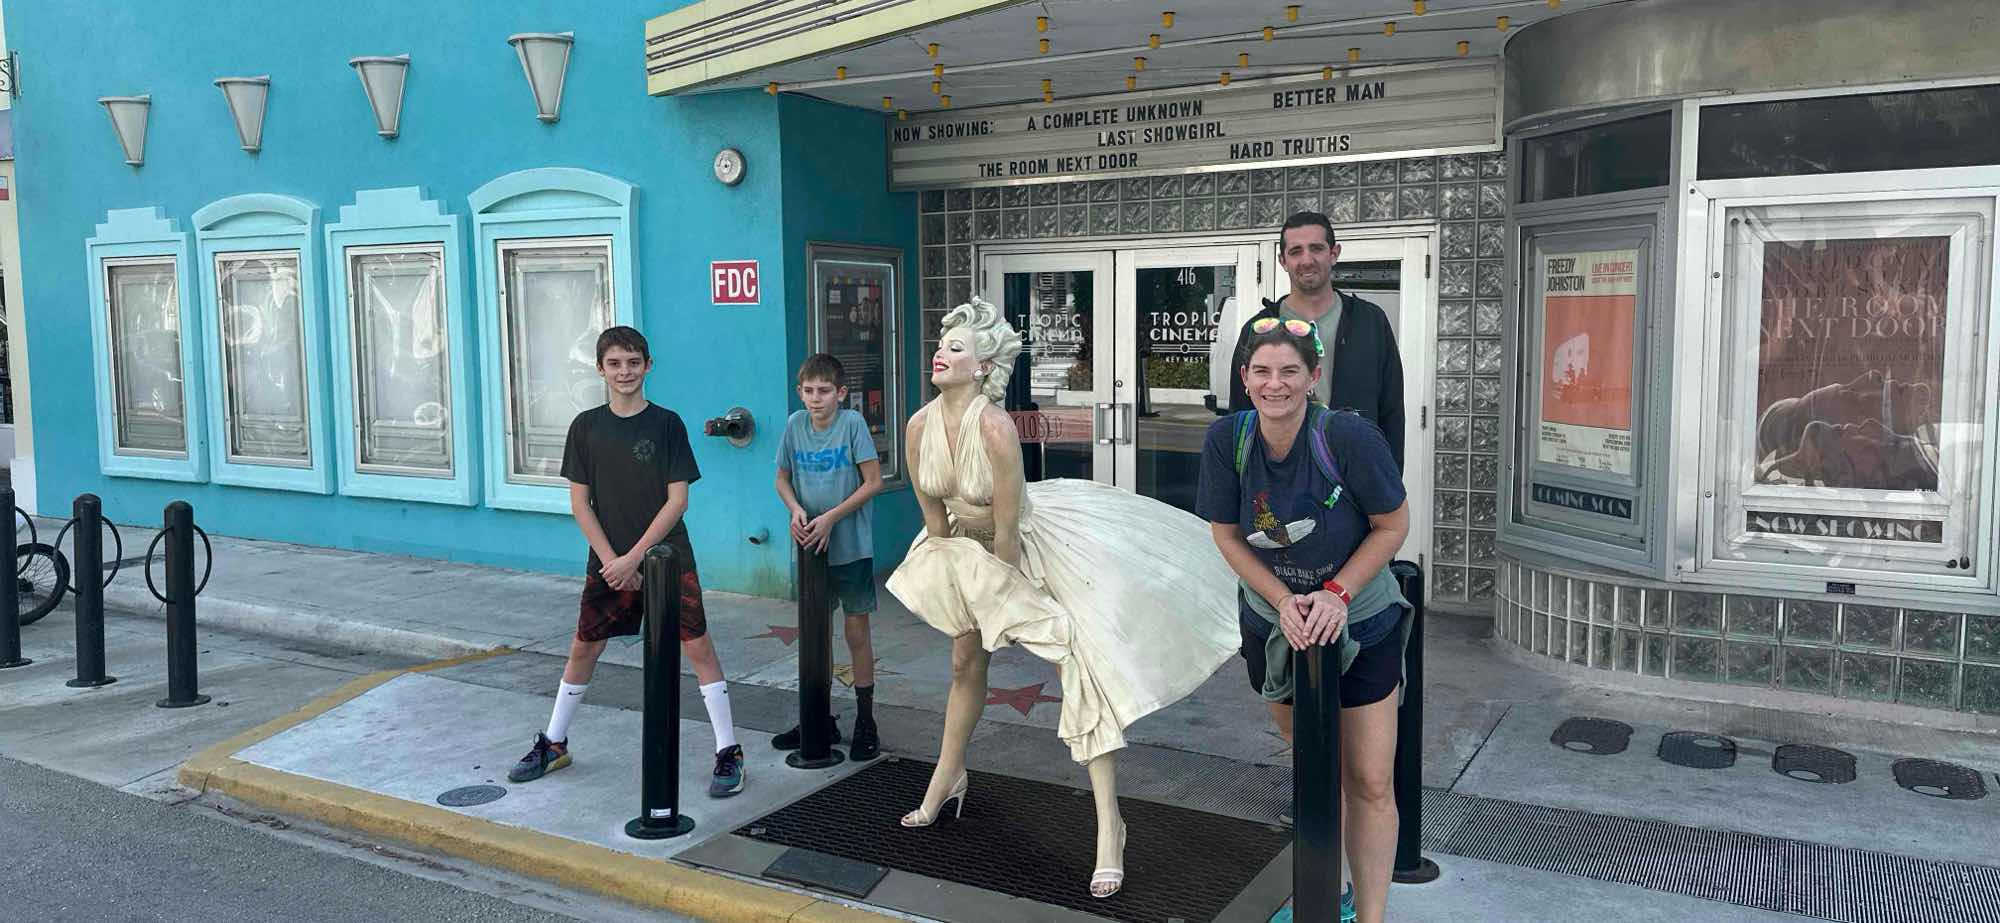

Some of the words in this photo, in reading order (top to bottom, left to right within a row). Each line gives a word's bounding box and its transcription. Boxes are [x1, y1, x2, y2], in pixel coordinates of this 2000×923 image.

[1273, 87, 1336, 109] BETTER
[1346, 82, 1385, 101] MAN
[1027, 117, 1037, 131] A
[1043, 109, 1118, 130] COMPLETE
[1126, 100, 1202, 122] UNKNOWN
[893, 127, 921, 142] NOW
[928, 121, 994, 140] SHOWING:
[1097, 131, 1136, 147] LAST
[1143, 121, 1225, 143] SHOWGIRL
[1230, 141, 1274, 159] HARD
[1283, 135, 1350, 156] TRUTHS
[978, 163, 1003, 178] THE
[1009, 158, 1049, 175] ROOM
[1056, 155, 1092, 172] NEXT
[1099, 152, 1138, 169] DOOR
[1177, 267, 1196, 286] 416
[1547, 257, 1576, 274] FREEDY
[714, 267, 757, 298] FDC
[1546, 275, 1586, 292] JOHNSTON
[1017, 314, 1081, 328] TROPIC
[1150, 312, 1221, 326] TROPIC
[1014, 415, 1063, 438] CLOSED
[1755, 515, 1808, 534] NOW
[1816, 518, 1926, 540] SHOWING
